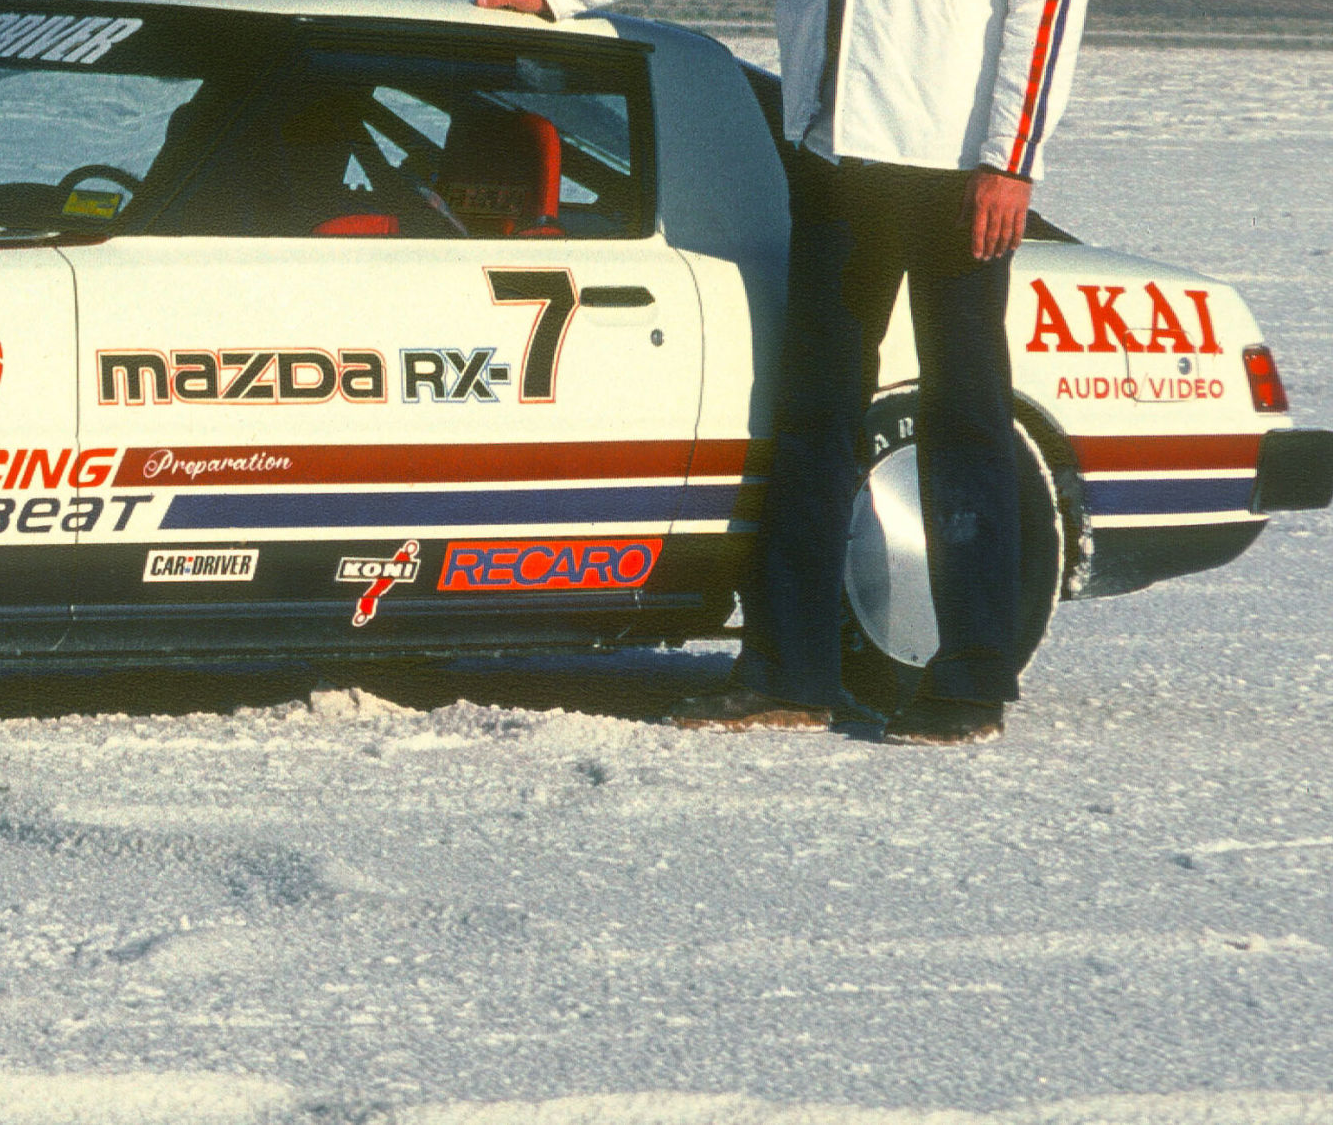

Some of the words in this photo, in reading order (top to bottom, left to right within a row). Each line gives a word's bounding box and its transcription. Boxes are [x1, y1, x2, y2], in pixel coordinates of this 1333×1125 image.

[1025, 278, 1223, 354] AKAI
[144, 449, 295, 481] Preparation
[191, 555, 252, 575] DRIVER
[343, 562, 413, 577] KONI
[445, 547, 652, 586] RECARO
